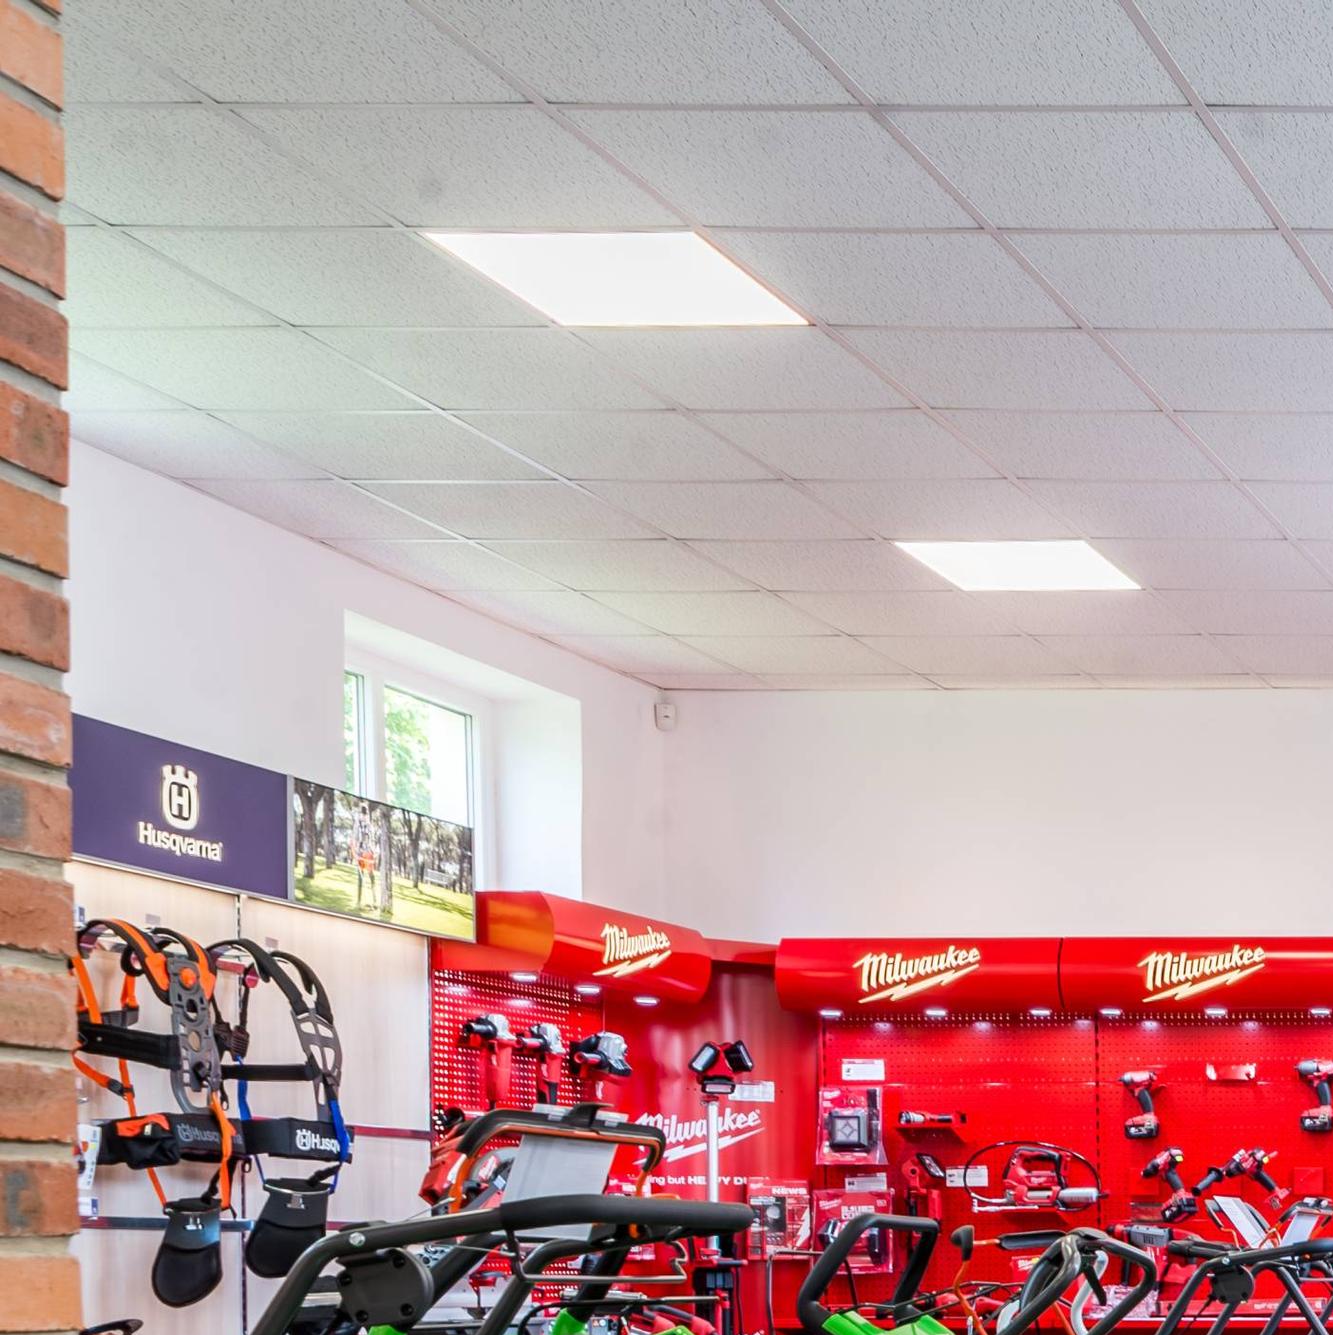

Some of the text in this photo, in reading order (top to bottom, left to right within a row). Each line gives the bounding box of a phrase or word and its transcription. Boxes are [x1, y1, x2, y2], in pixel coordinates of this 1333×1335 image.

[138, 821, 223, 862] Husqvarna
[600, 922, 671, 965] Milwaukee
[852, 944, 981, 992] Milwaukee
[1136, 944, 1266, 991] Milwaukee
[667, 1175, 686, 1185] but
